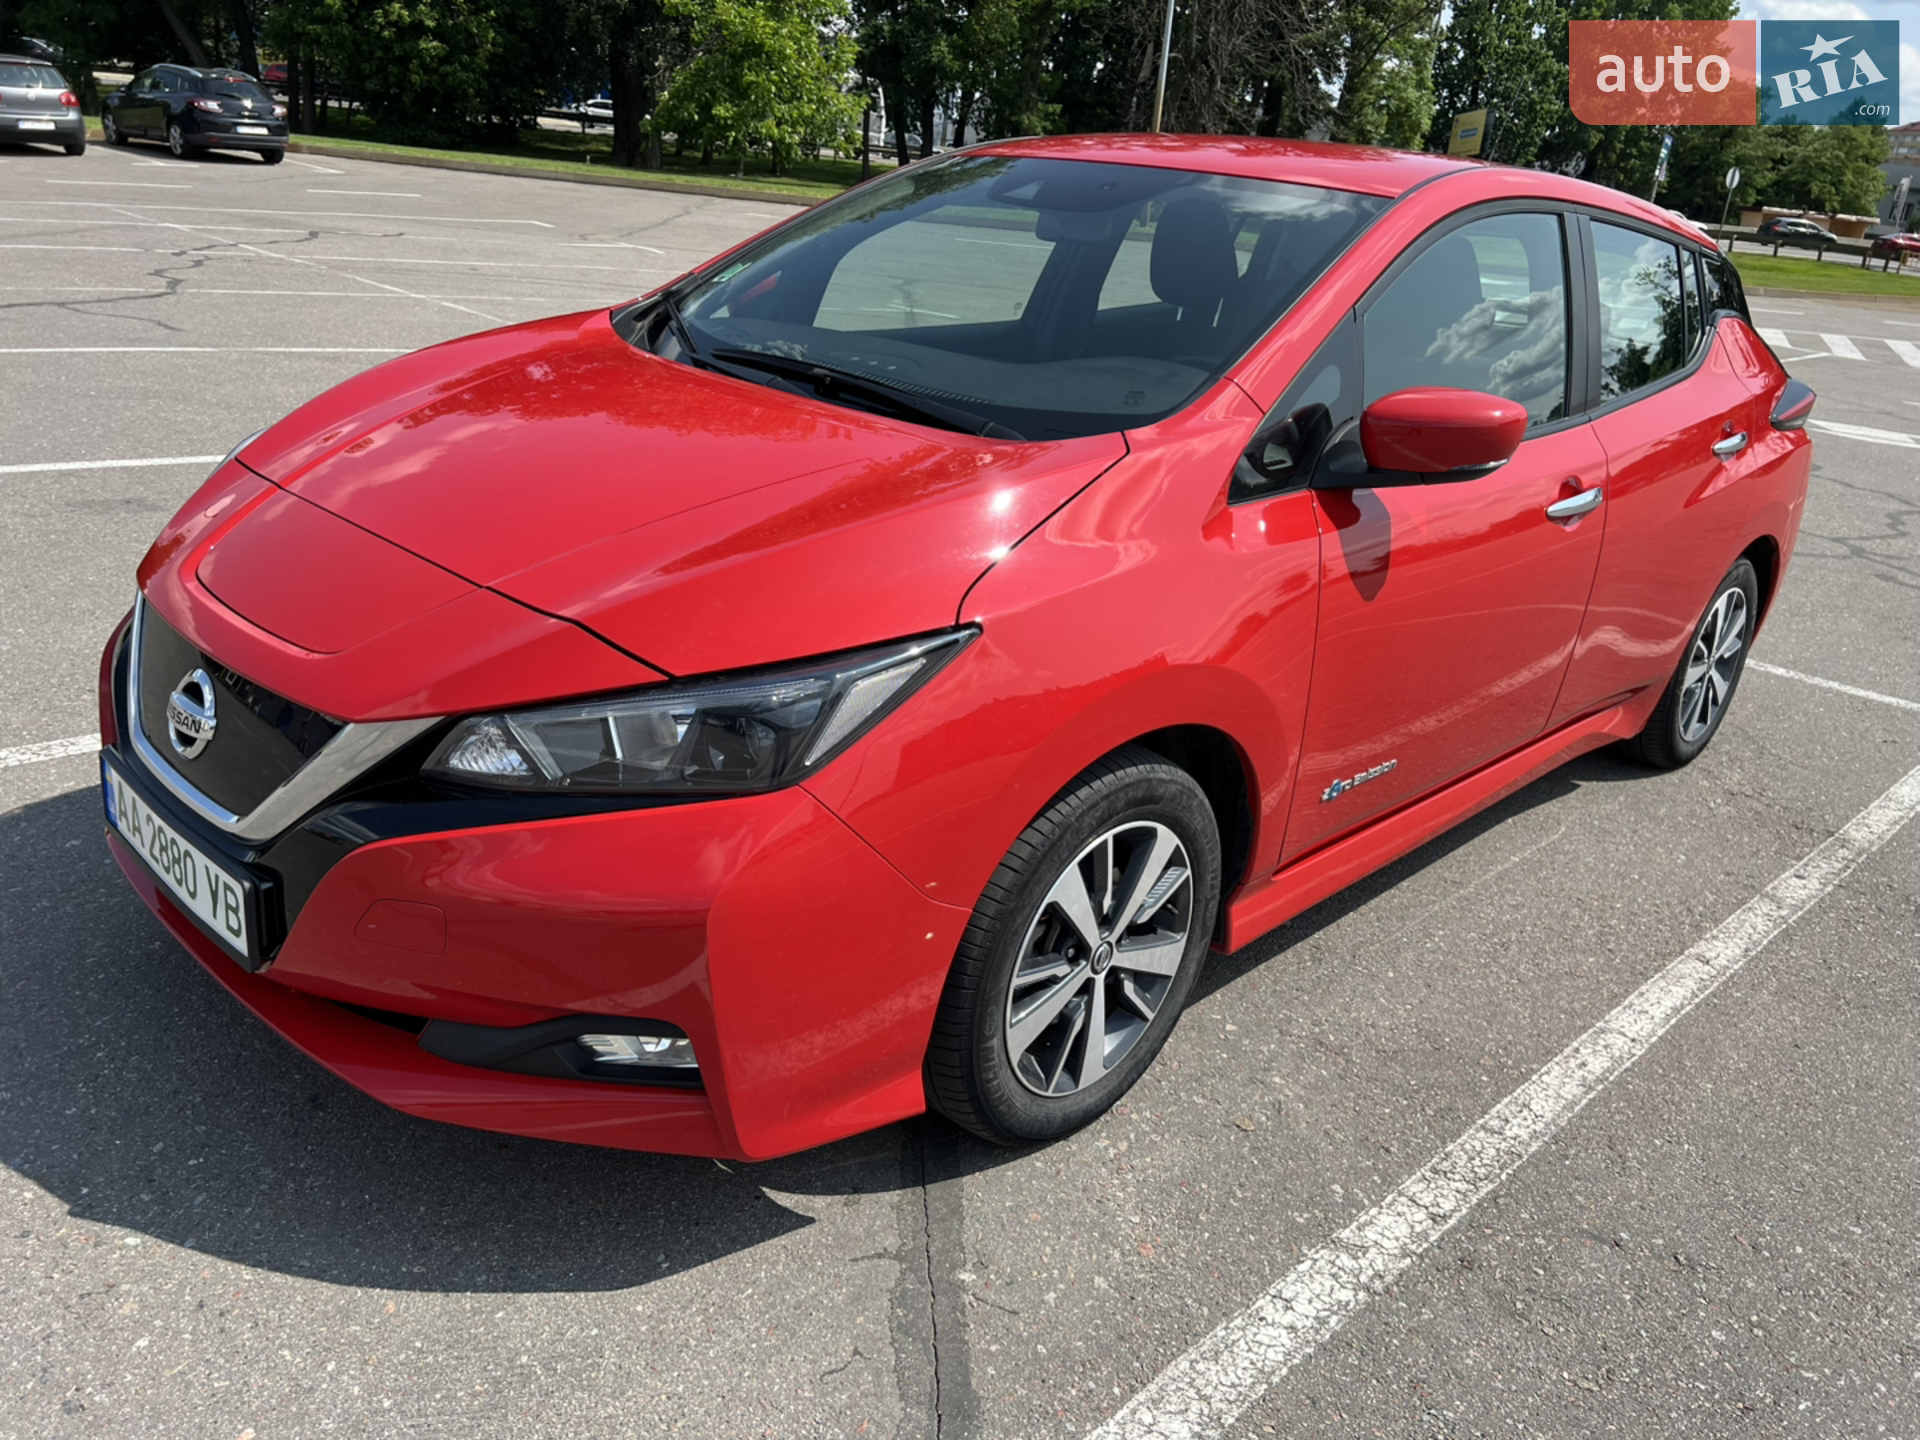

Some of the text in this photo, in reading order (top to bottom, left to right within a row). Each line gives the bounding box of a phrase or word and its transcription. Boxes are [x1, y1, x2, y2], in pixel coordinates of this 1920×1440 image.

[117, 780, 242, 939] AA 2880 YB
